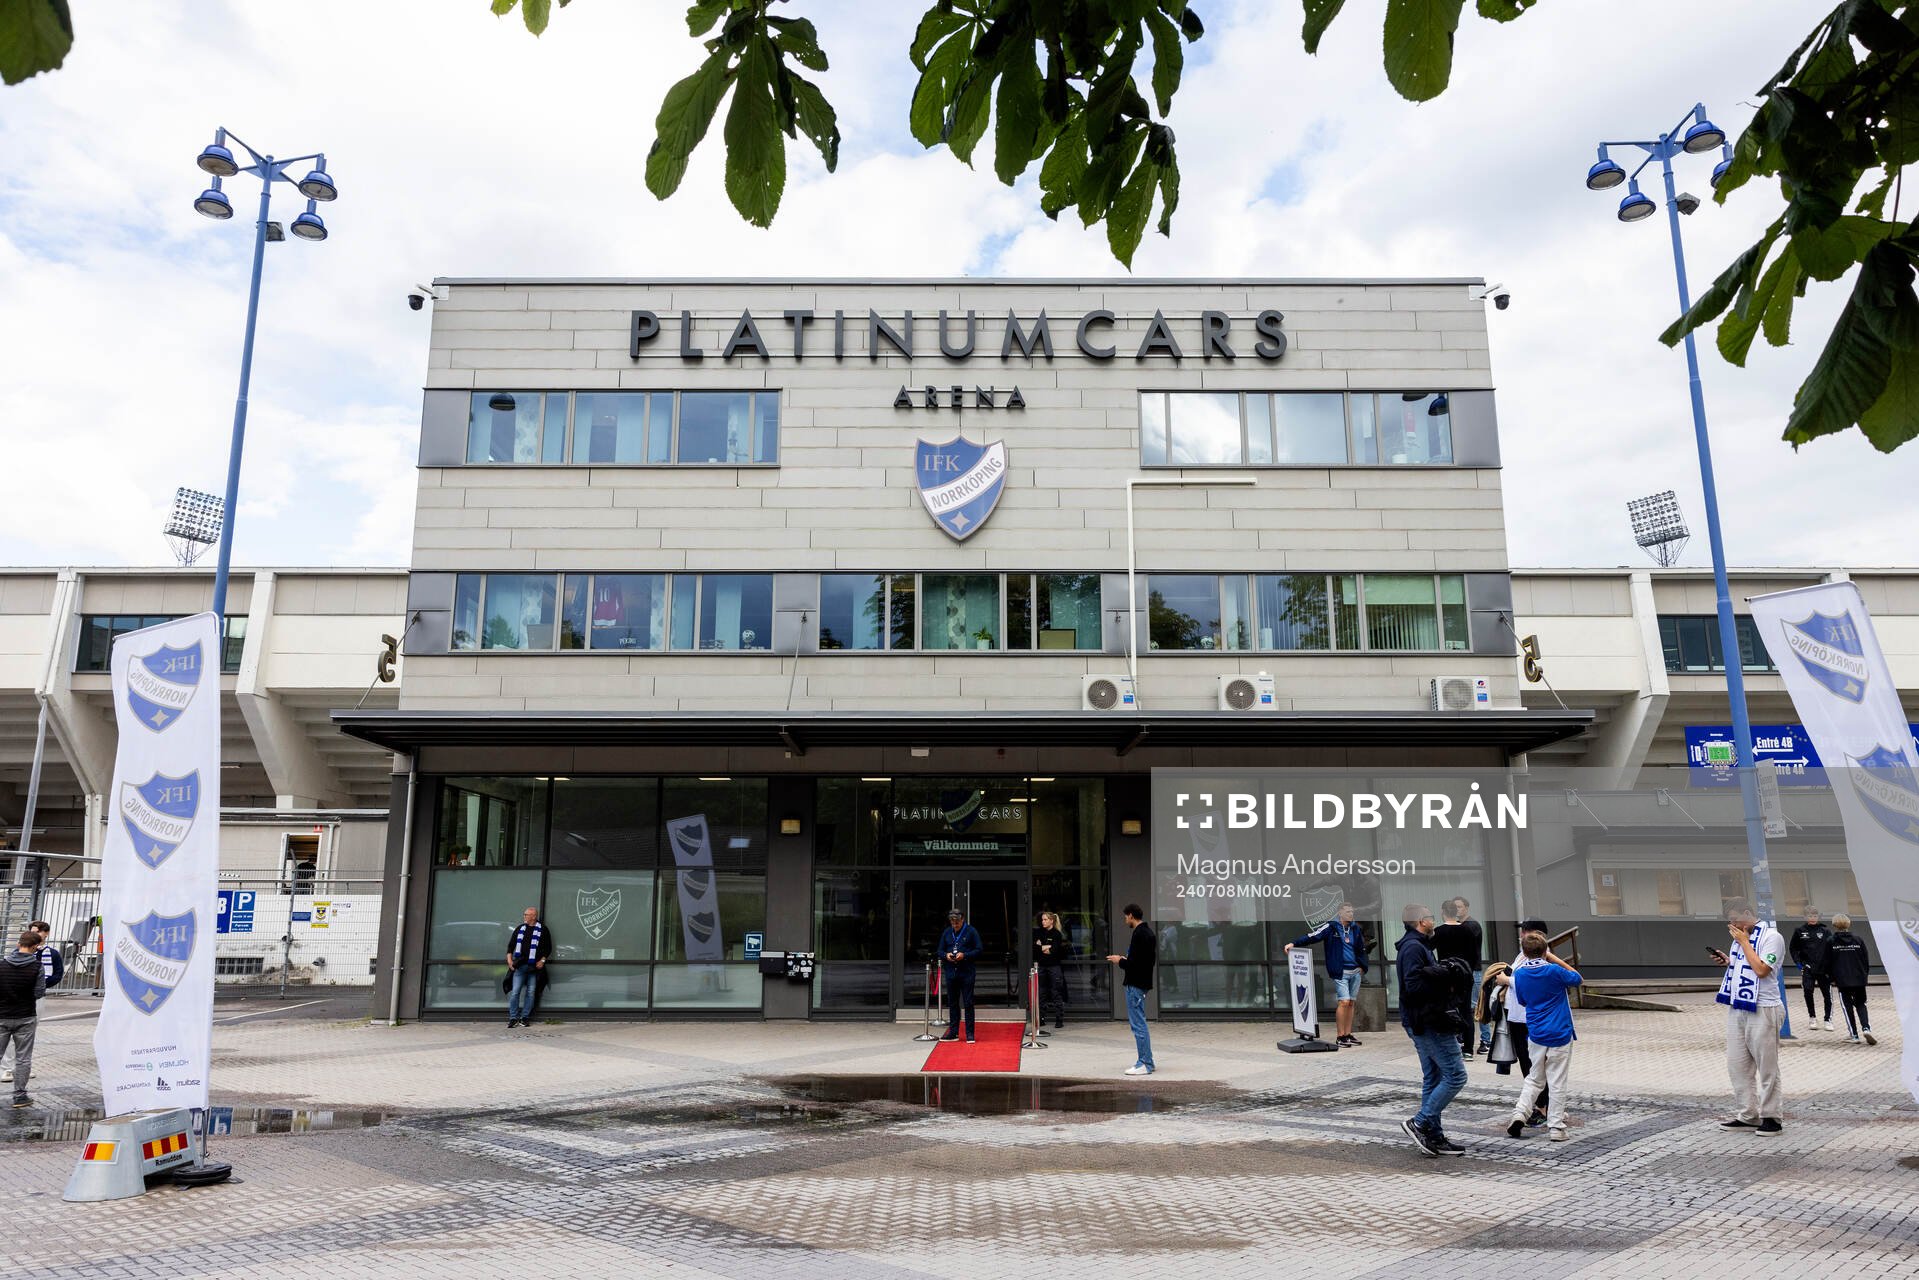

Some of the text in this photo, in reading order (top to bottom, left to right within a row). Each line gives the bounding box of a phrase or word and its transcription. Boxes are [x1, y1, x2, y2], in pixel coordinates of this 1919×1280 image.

[630, 307, 1288, 360] PLATINUMCARS
[893, 384, 1026, 408] ARENA
[923, 454, 961, 472] IFK
[930, 457, 1002, 509] NORRKÖPING
[1756, 737, 1781, 748] Entré
[1775, 764, 1792, 776] ntré
[893, 806, 1022, 820] PLATINCARS
[923, 839, 999, 851] Välkommen
[238, 892, 253, 910] P
[581, 896, 600, 907] IFK
[583, 898, 618, 925] NORRKÖPING
